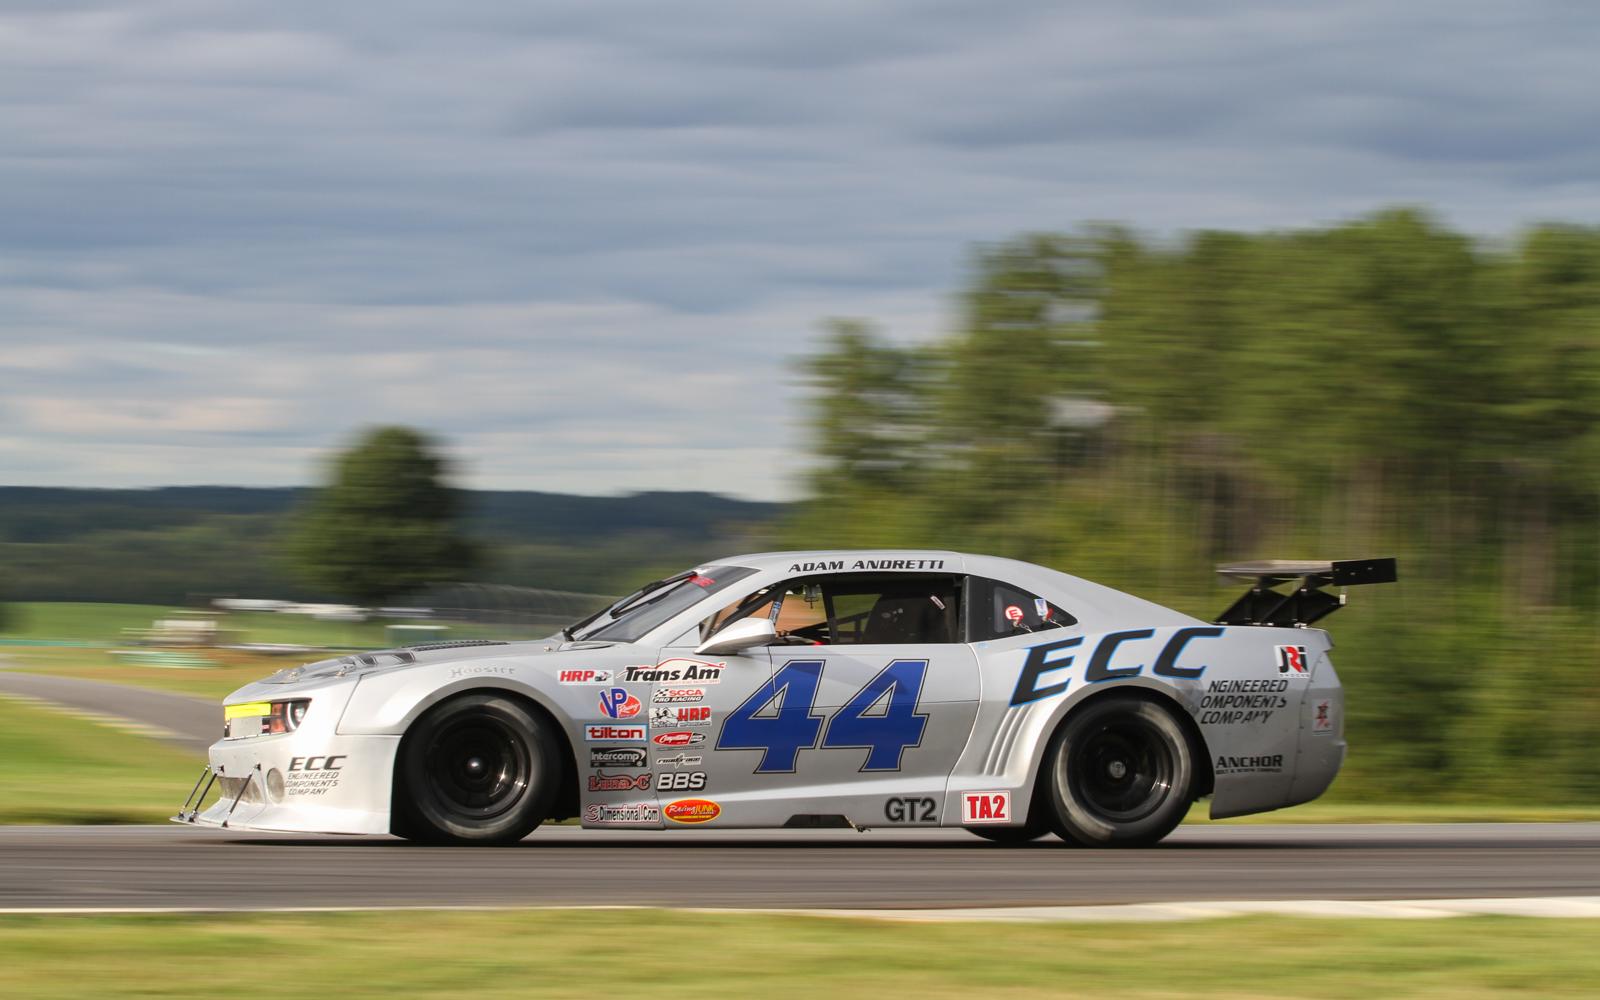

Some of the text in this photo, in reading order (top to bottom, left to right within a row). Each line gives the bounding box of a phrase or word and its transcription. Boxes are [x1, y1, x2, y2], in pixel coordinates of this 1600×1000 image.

[788, 560, 945, 573] ADAM ANDRETTI
[624, 664, 720, 682] Trans Am
[1008, 627, 1226, 707] ECC
[559, 670, 595, 682] HRP
[668, 689, 703, 697] SCCA
[600, 687, 627, 719] VP
[677, 707, 711, 721] HRP
[714, 658, 931, 775] 44
[588, 727, 643, 738] tilton
[288, 755, 347, 771] ECC
[591, 751, 640, 763] Intercomp
[1215, 754, 1283, 768] ANCHOR
[657, 772, 707, 792] BBS
[884, 796, 938, 822] GT2
[966, 795, 1006, 819] TA2
